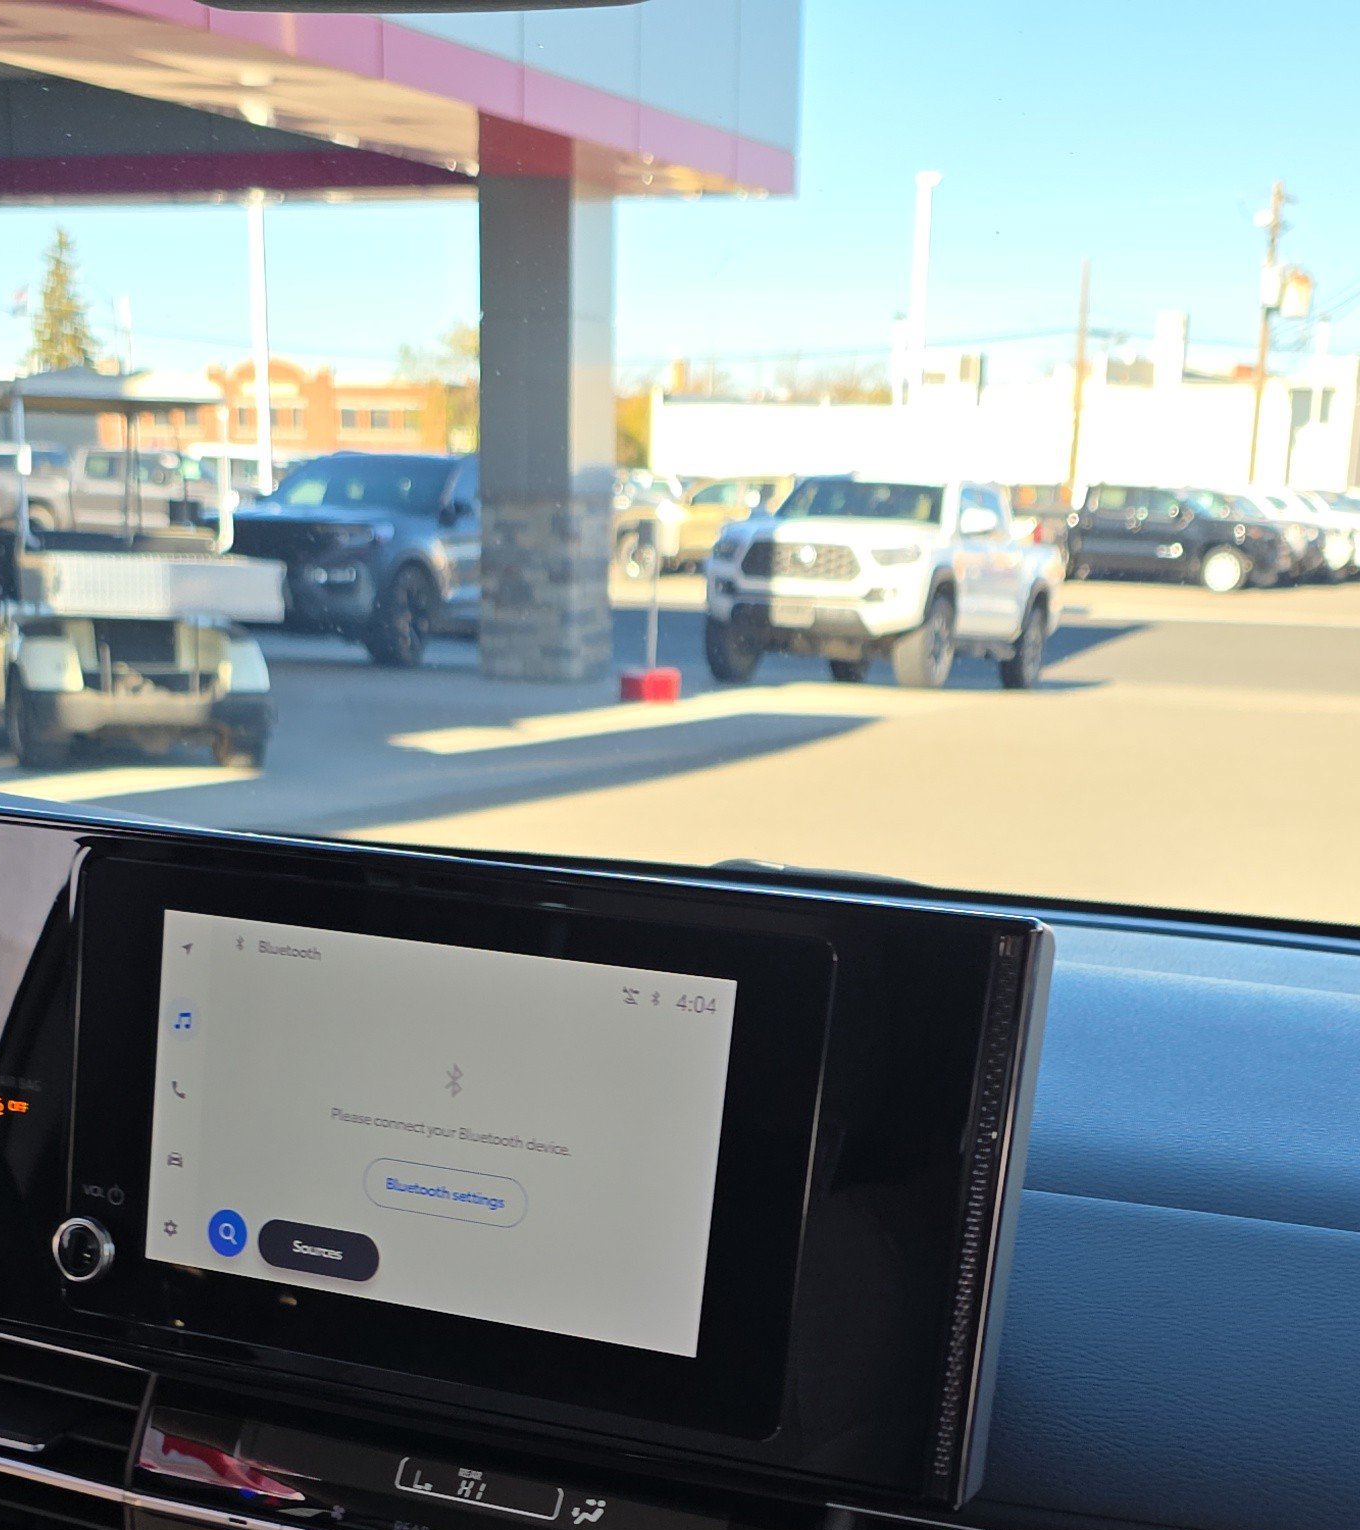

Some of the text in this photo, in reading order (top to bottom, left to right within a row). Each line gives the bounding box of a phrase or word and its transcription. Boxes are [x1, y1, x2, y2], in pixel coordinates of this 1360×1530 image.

[259, 940, 322, 961] Bluetooth
[676, 994, 717, 1015] 4:04
[330, 1107, 572, 1157] Please connect your Bluetooth device.
[385, 1177, 506, 1211] Bluetooth settings
[292, 1239, 344, 1261] Sources
